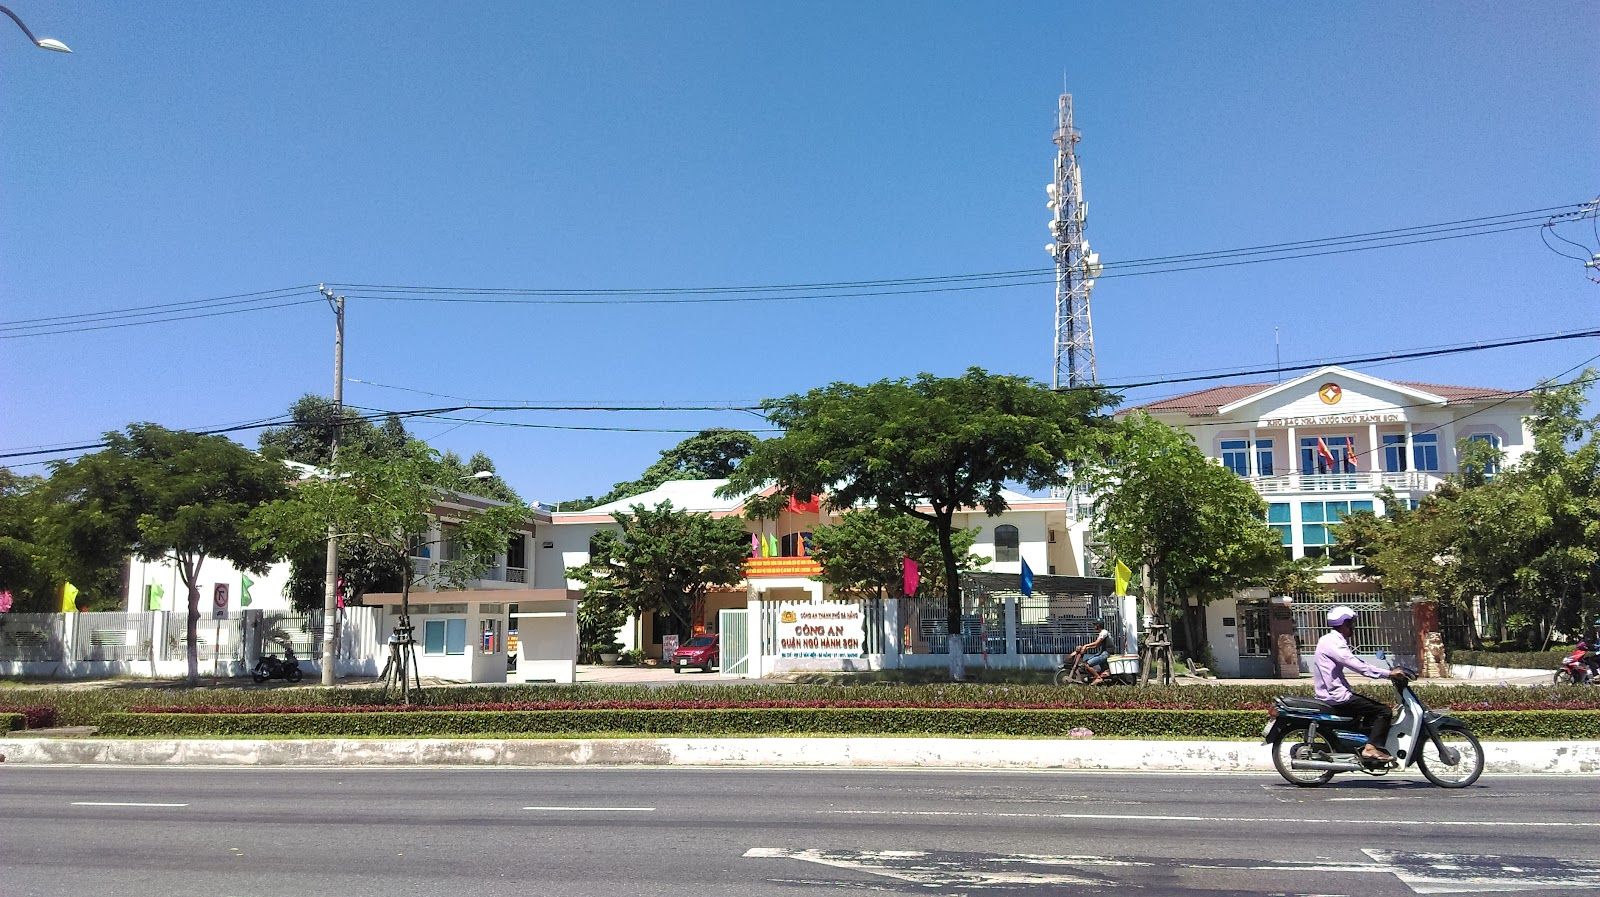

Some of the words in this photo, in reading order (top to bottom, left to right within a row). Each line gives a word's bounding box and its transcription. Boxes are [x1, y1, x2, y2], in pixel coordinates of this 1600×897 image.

[795, 624, 825, 636] CÔNG
[828, 625, 843, 636] AN
[781, 637, 801, 650] QUẬN
[803, 637, 818, 649] NGŨ
[821, 637, 841, 649] HÀNH
[843, 637, 858, 649] SƠN
